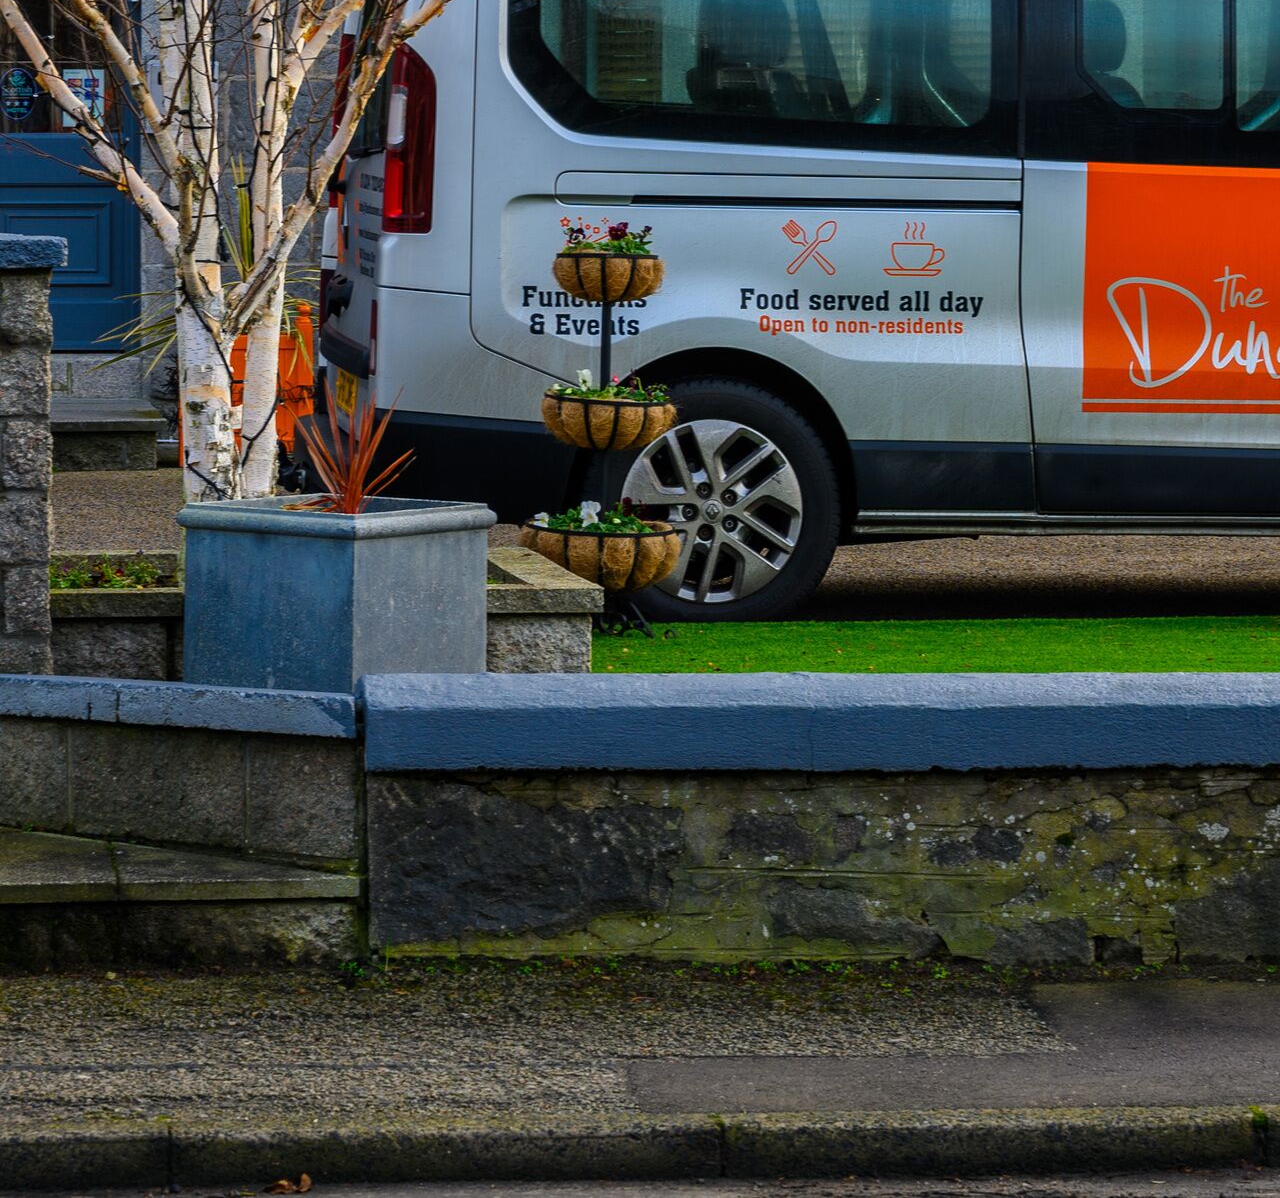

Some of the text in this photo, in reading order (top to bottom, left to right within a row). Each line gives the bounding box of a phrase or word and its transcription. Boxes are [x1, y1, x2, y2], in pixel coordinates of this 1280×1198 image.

[740, 288, 984, 318] Food served all day
[529, 313, 545, 335] &
[759, 314, 964, 335] Open to non-residents
